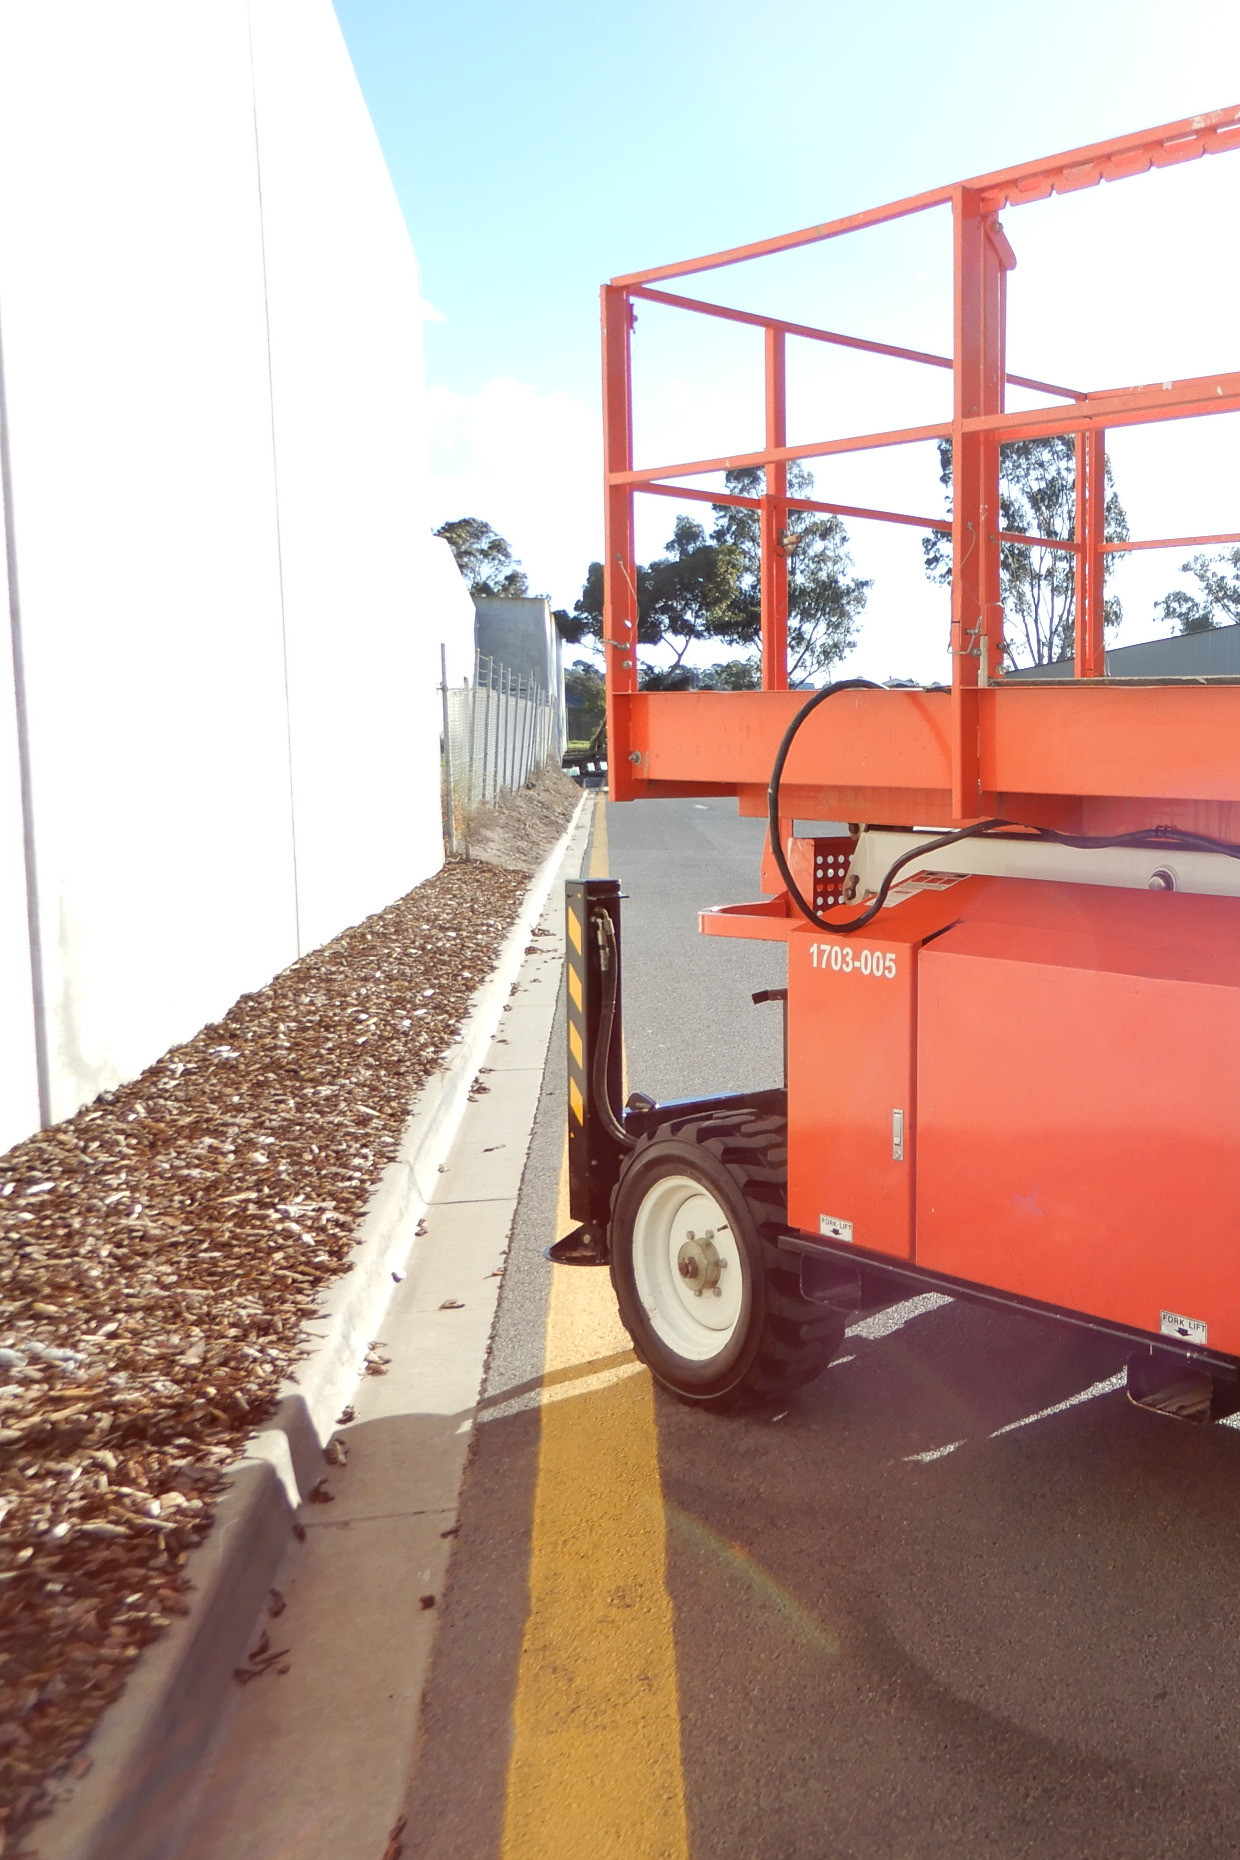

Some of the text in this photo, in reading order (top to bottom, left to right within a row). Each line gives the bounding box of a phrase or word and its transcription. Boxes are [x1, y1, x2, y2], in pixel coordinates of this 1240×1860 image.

[809, 943, 896, 979] 1703-005
[822, 1218, 852, 1231] FORK LIFT
[1162, 1314, 1206, 1333] FORK LIFT
